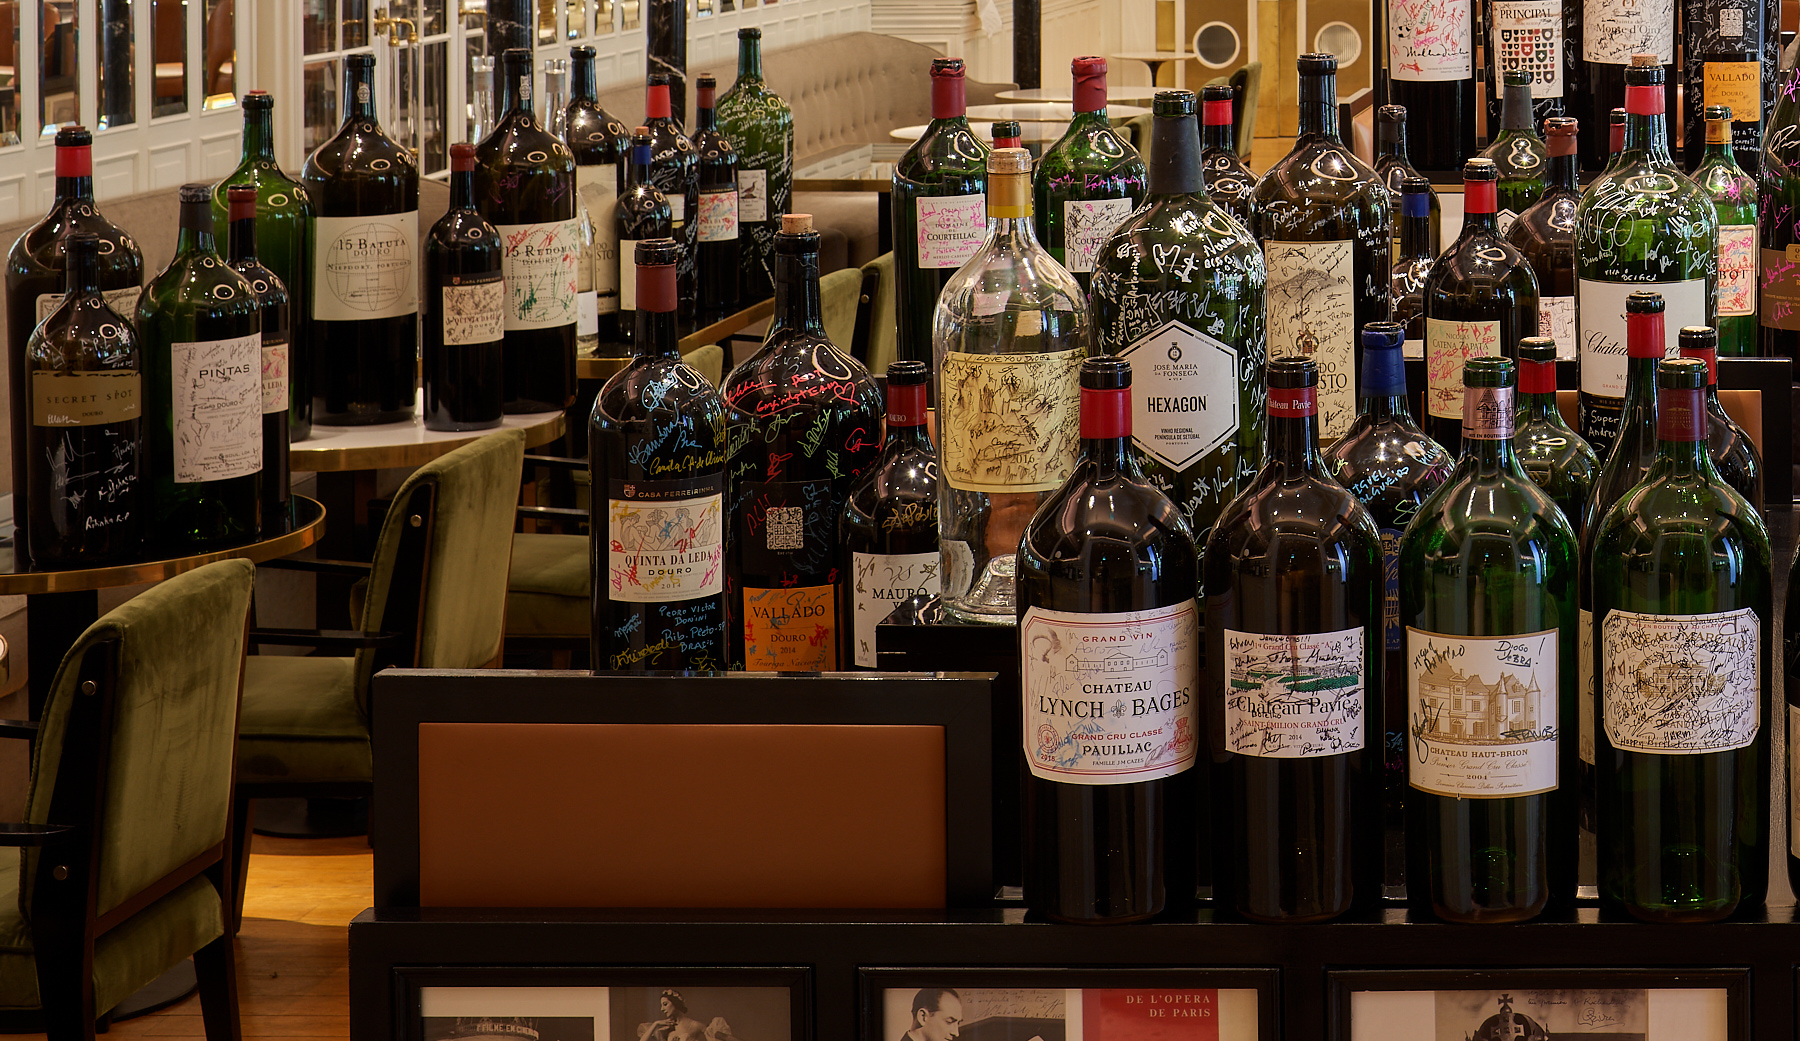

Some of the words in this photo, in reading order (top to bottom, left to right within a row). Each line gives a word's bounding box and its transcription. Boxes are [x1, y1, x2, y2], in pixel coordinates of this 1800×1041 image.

[1500, 7, 1554, 20] PRINCIPAL
[1709, 72, 1755, 82] VALLADO
[1721, 89, 1744, 97] DOURO
[935, 221, 968, 229] DOMAINE
[926, 231, 978, 242] COURTEILLAC
[353, 247, 391, 258] DOURO
[1458, 339, 1489, 351] ZAPATA
[199, 363, 250, 379] PINTAS
[1152, 363, 1171, 372] JOSÉ
[46, 394, 98, 405] SECRET
[106, 389, 133, 402] SPOT
[217, 400, 239, 409] DOURO
[1147, 394, 1208, 413] HEXAGON
[82, 410, 104, 418] DOURO
[1590, 409, 1620, 424] Super
[637, 491, 662, 499] CASA
[664, 485, 715, 498] FERREIRINHA
[625, 554, 667, 568] QUINTA
[670, 554, 684, 566] DA
[688, 550, 713, 564] LEDA
[648, 566, 692, 577] DOURO
[661, 582, 682, 590] 2014
[752, 603, 826, 619] VALLADO
[770, 633, 807, 643] DOURO
[1133, 632, 1153, 641] VIN
[780, 646, 796, 654] 2014
[752, 658, 786, 670] Touriga
[1082, 680, 1153, 694] CHATEAU
[1039, 695, 1105, 718] LYNCH
[1131, 687, 1191, 717] BAGES
[1308, 697, 1351, 714] Pavie
[1243, 719, 1300, 729] SAINT-ÉMILION
[1300, 720, 1330, 728] GRAND
[1330, 718, 1345, 727] CRU
[1082, 741, 1153, 757] PAUILLAC
[1430, 747, 1468, 758] CHATEAU
[1471, 748, 1528, 758] HAUT-BRION
[1458, 758, 1484, 771] Grand
[1486, 760, 1501, 770] Cru
[1126, 994, 1144, 1005] DE
[1149, 994, 1211, 1005] L'OPERA
[1149, 1007, 1167, 1018] DE
[1171, 1007, 1211, 1018] PARIS
